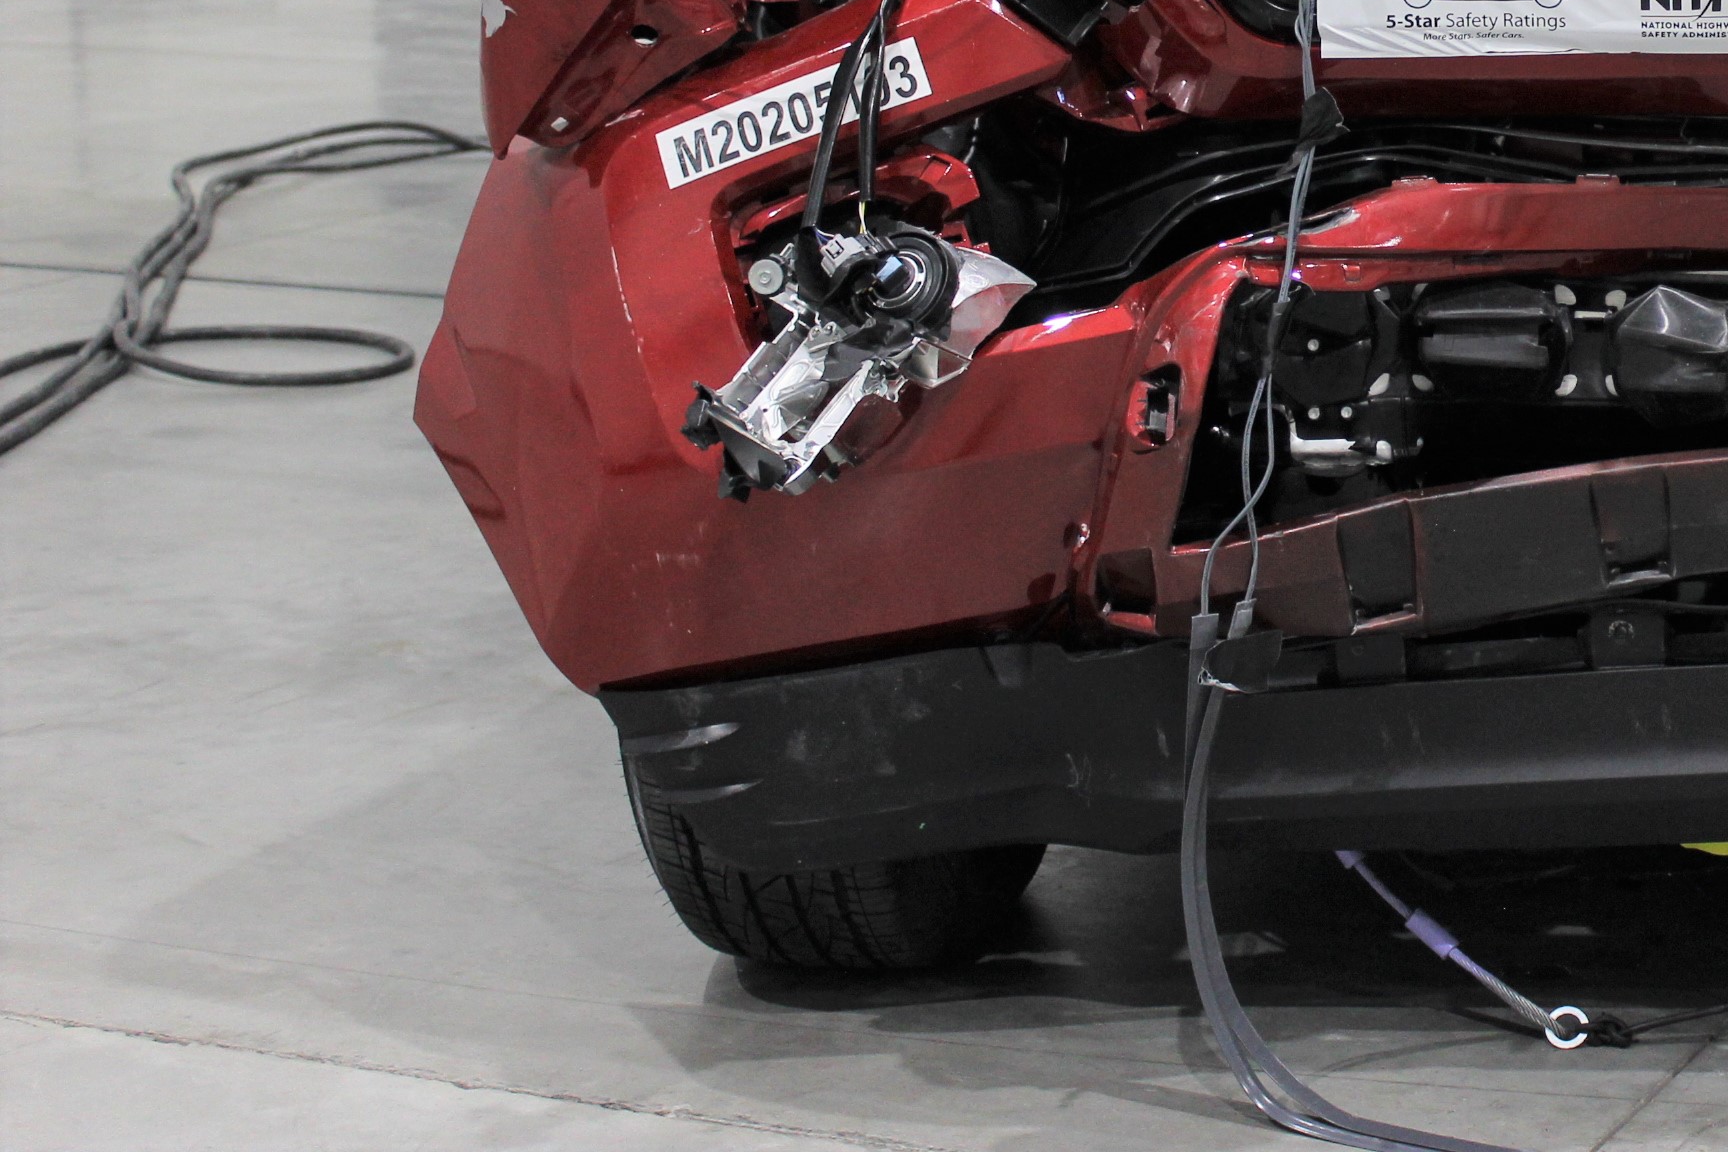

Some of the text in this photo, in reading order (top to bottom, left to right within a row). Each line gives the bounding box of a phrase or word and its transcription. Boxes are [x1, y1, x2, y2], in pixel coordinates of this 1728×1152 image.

[1386, 13, 1566, 31] 5-Star Safety Ratings
[1641, 21, 1693, 30] NATIONAL
[1423, 31, 1525, 41] More Stars. Safer Cars.
